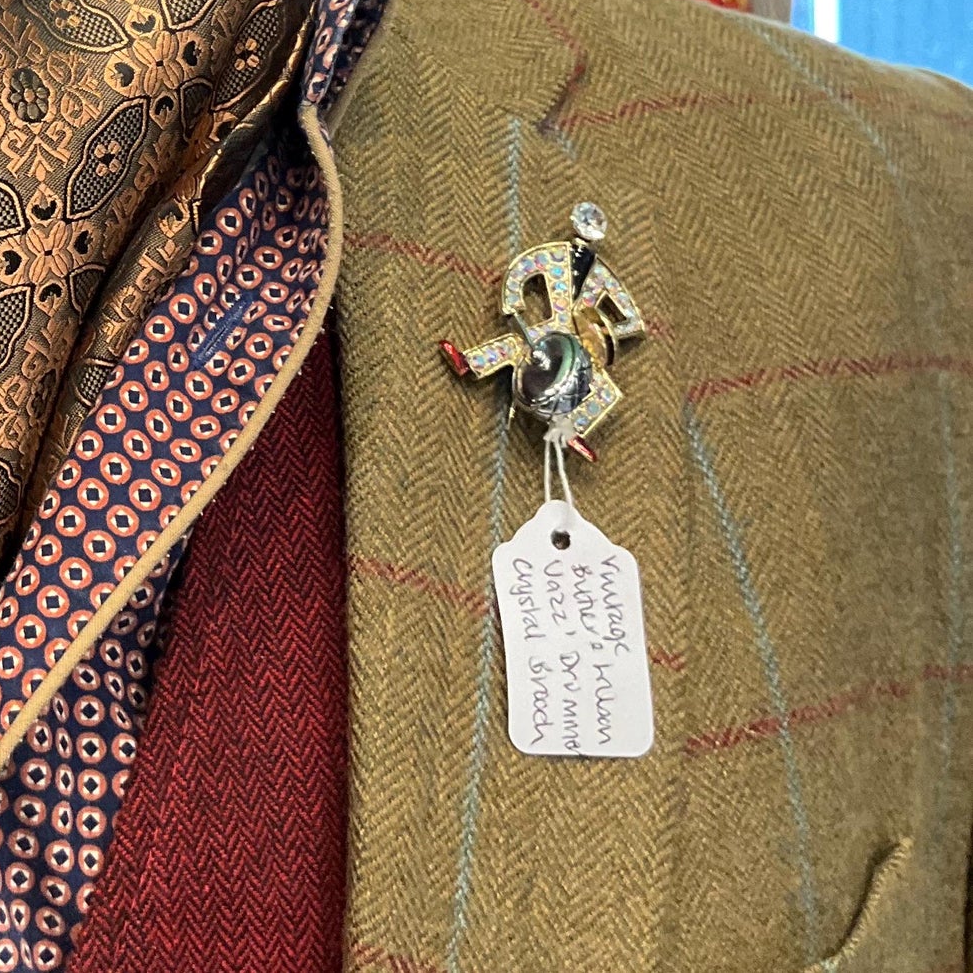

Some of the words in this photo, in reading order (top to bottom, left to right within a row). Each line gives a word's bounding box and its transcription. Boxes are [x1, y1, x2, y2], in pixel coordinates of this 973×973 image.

[509, 558, 546, 640] Crystal
[528, 655, 554, 746] Brooch
[599, 555, 630, 656] Vintage
[592, 663, 615, 745] Wilson
